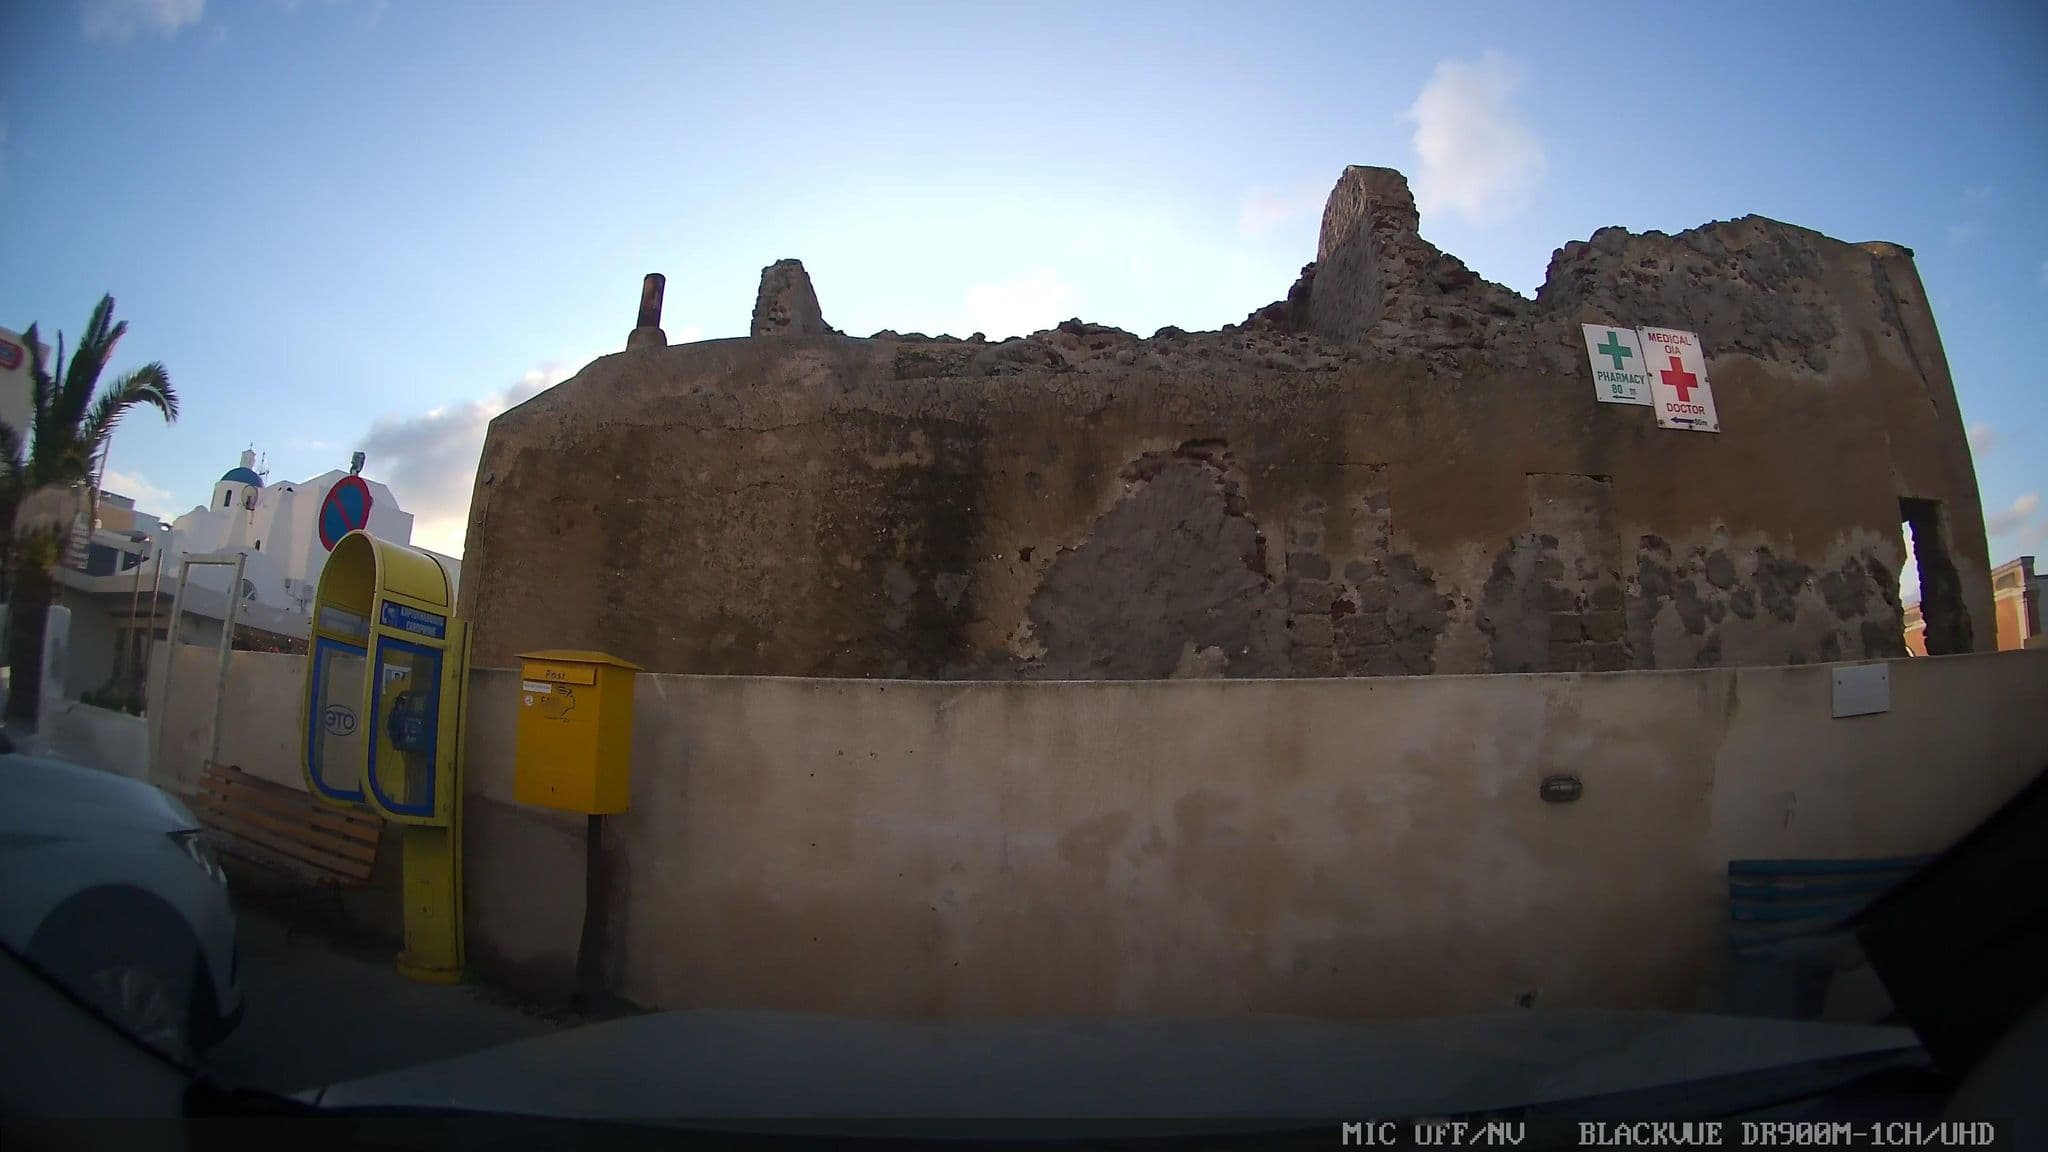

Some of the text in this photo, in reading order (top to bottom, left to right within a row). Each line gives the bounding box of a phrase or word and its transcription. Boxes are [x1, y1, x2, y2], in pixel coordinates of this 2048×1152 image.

[1648, 332, 1692, 346] MEDICAL
[1664, 344, 1682, 354] OIA
[1597, 370, 1645, 385] PHARMACY
[1611, 383, 1623, 394] 80
[1666, 402, 1706, 416] DOCTOR
